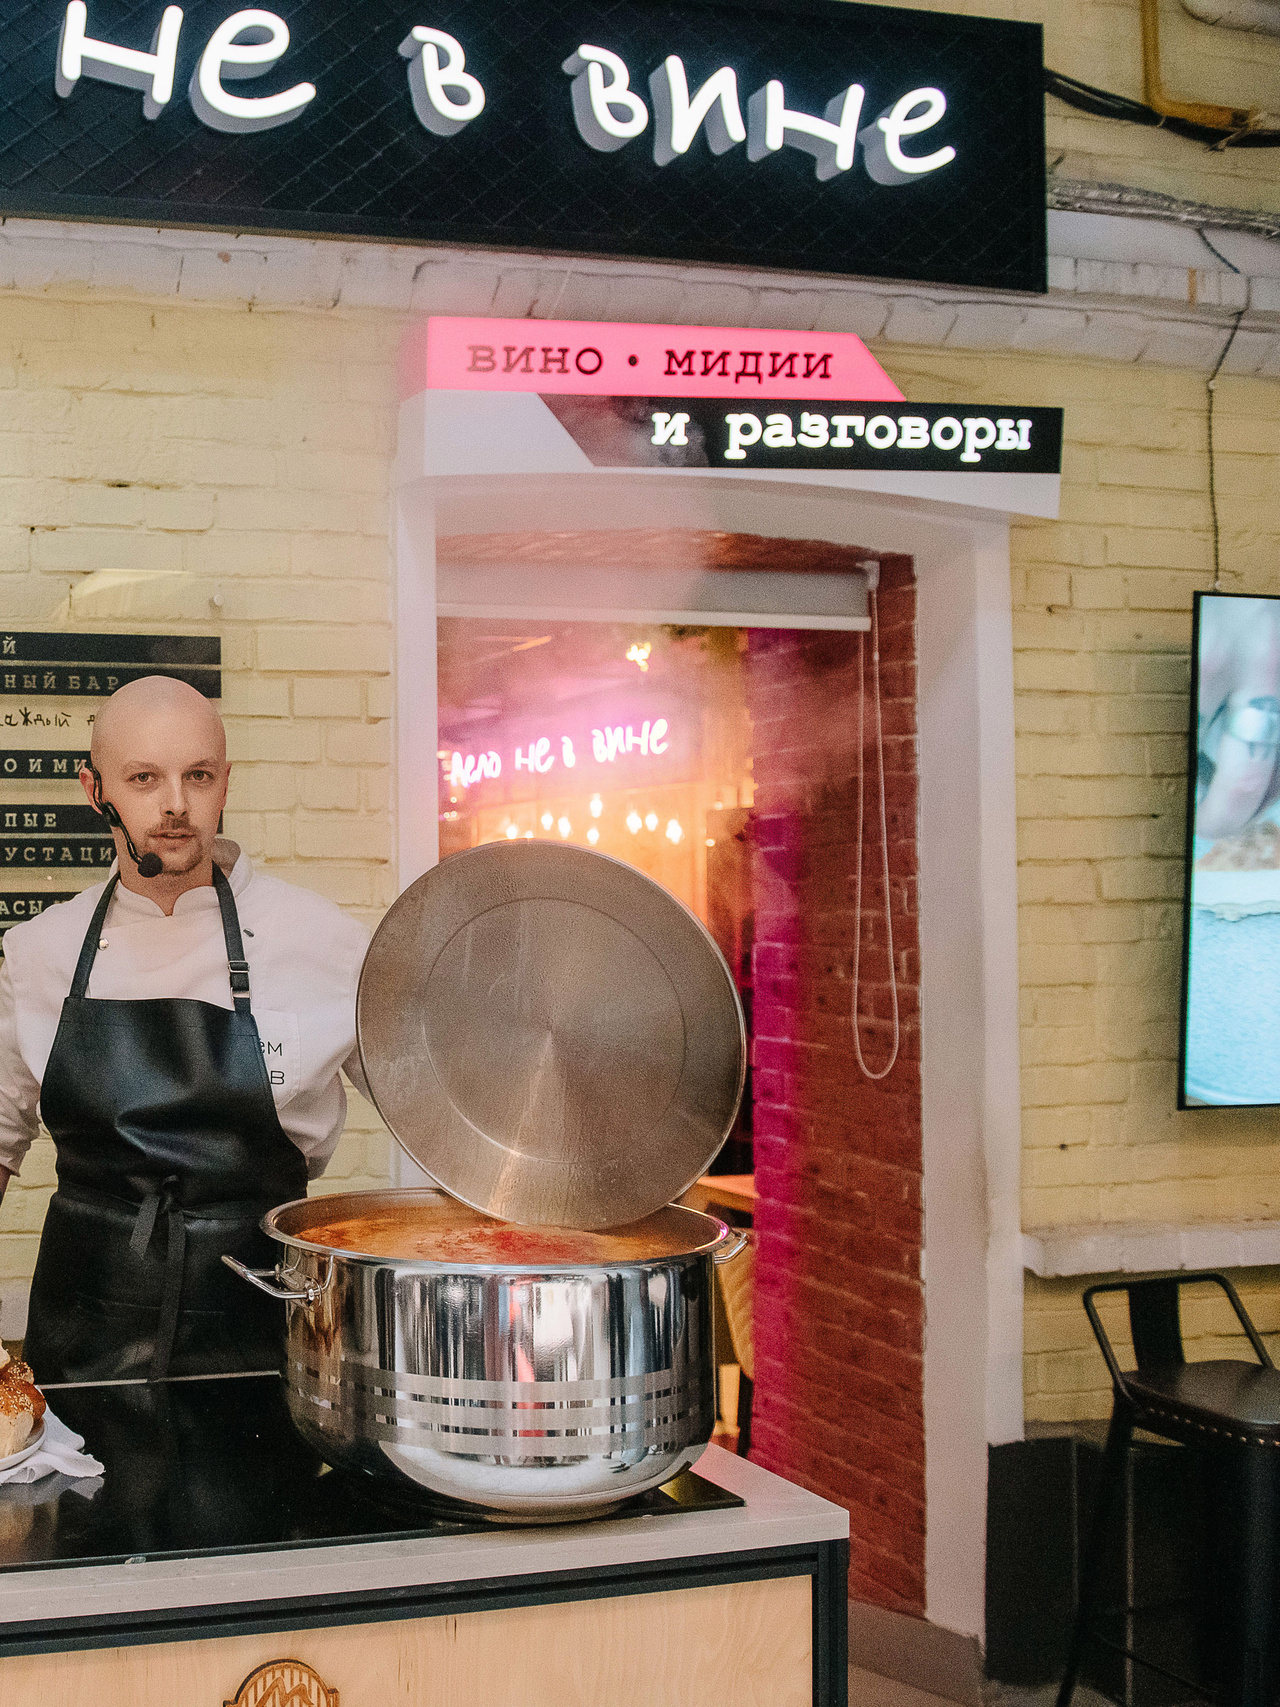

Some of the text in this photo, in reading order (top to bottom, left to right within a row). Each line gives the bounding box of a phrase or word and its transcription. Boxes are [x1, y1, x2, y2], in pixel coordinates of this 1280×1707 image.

[570, 43, 957, 178] вине
[650, 411, 1033, 463] и разговоры
[68, 675, 119, 690] БАР
[28, 757, 42, 773] И
